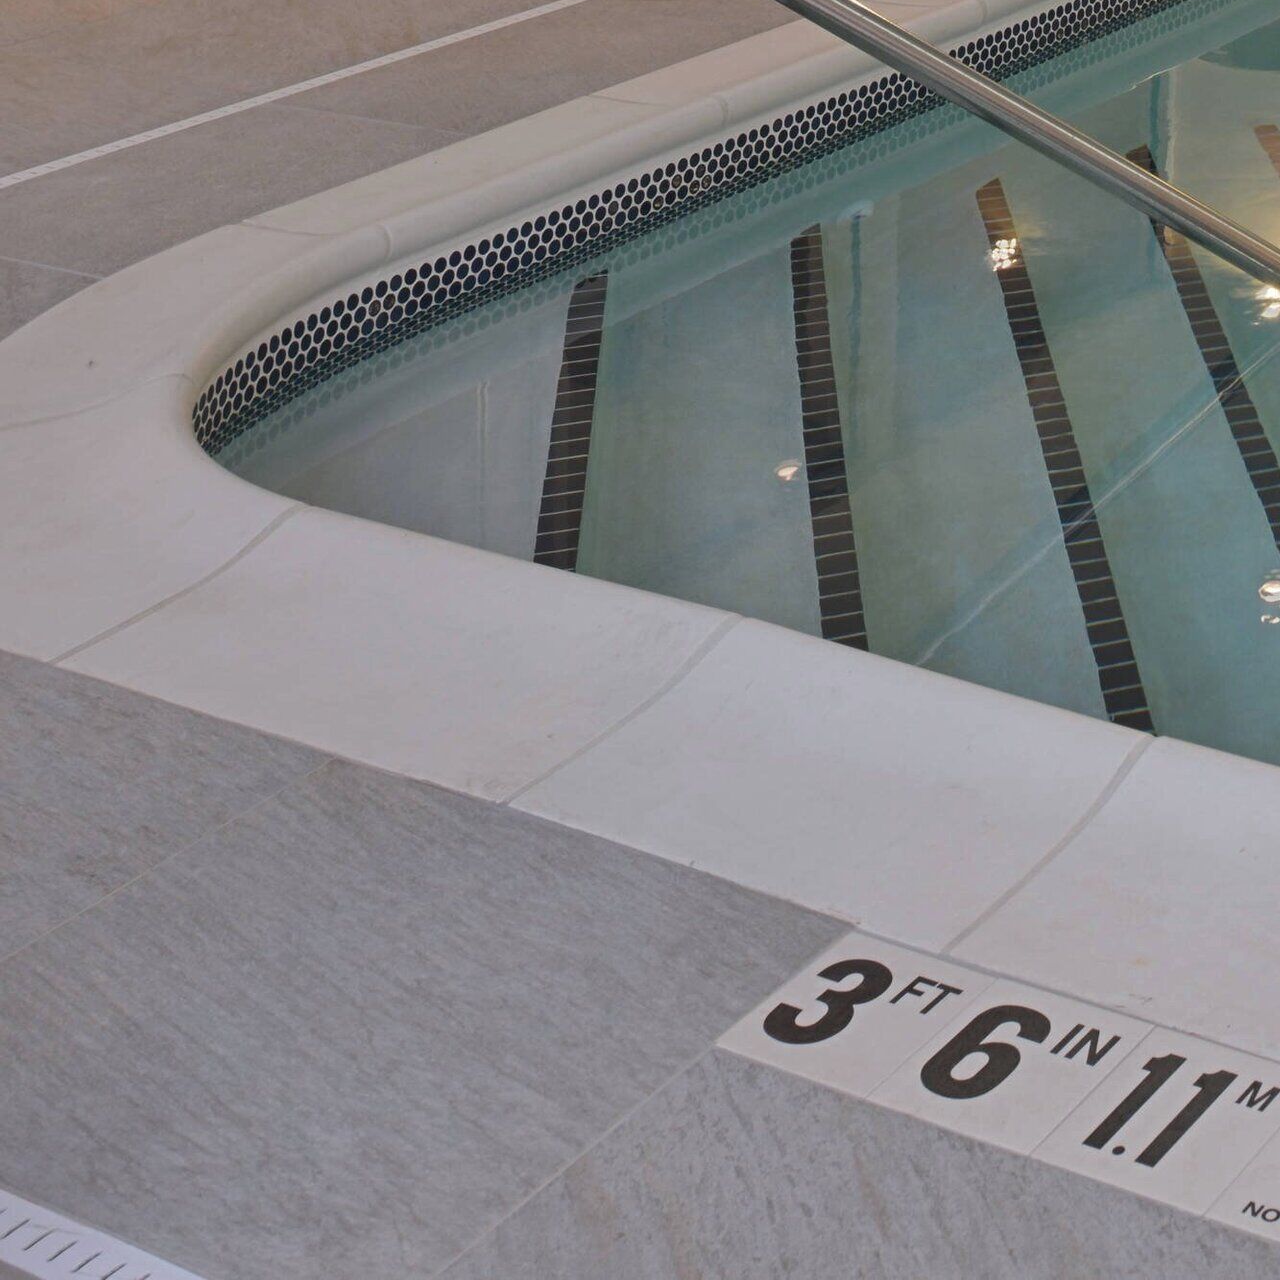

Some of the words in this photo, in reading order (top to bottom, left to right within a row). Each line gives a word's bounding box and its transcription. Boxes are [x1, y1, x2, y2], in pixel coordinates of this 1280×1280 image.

[763, 958, 894, 1045] 3
[888, 976, 964, 1015] FT
[919, 1004, 1052, 1100] 6
[1049, 1023, 1122, 1067] IN
[1081, 1053, 1239, 1168] 1.1
[1242, 1201, 1280, 1223] NO
